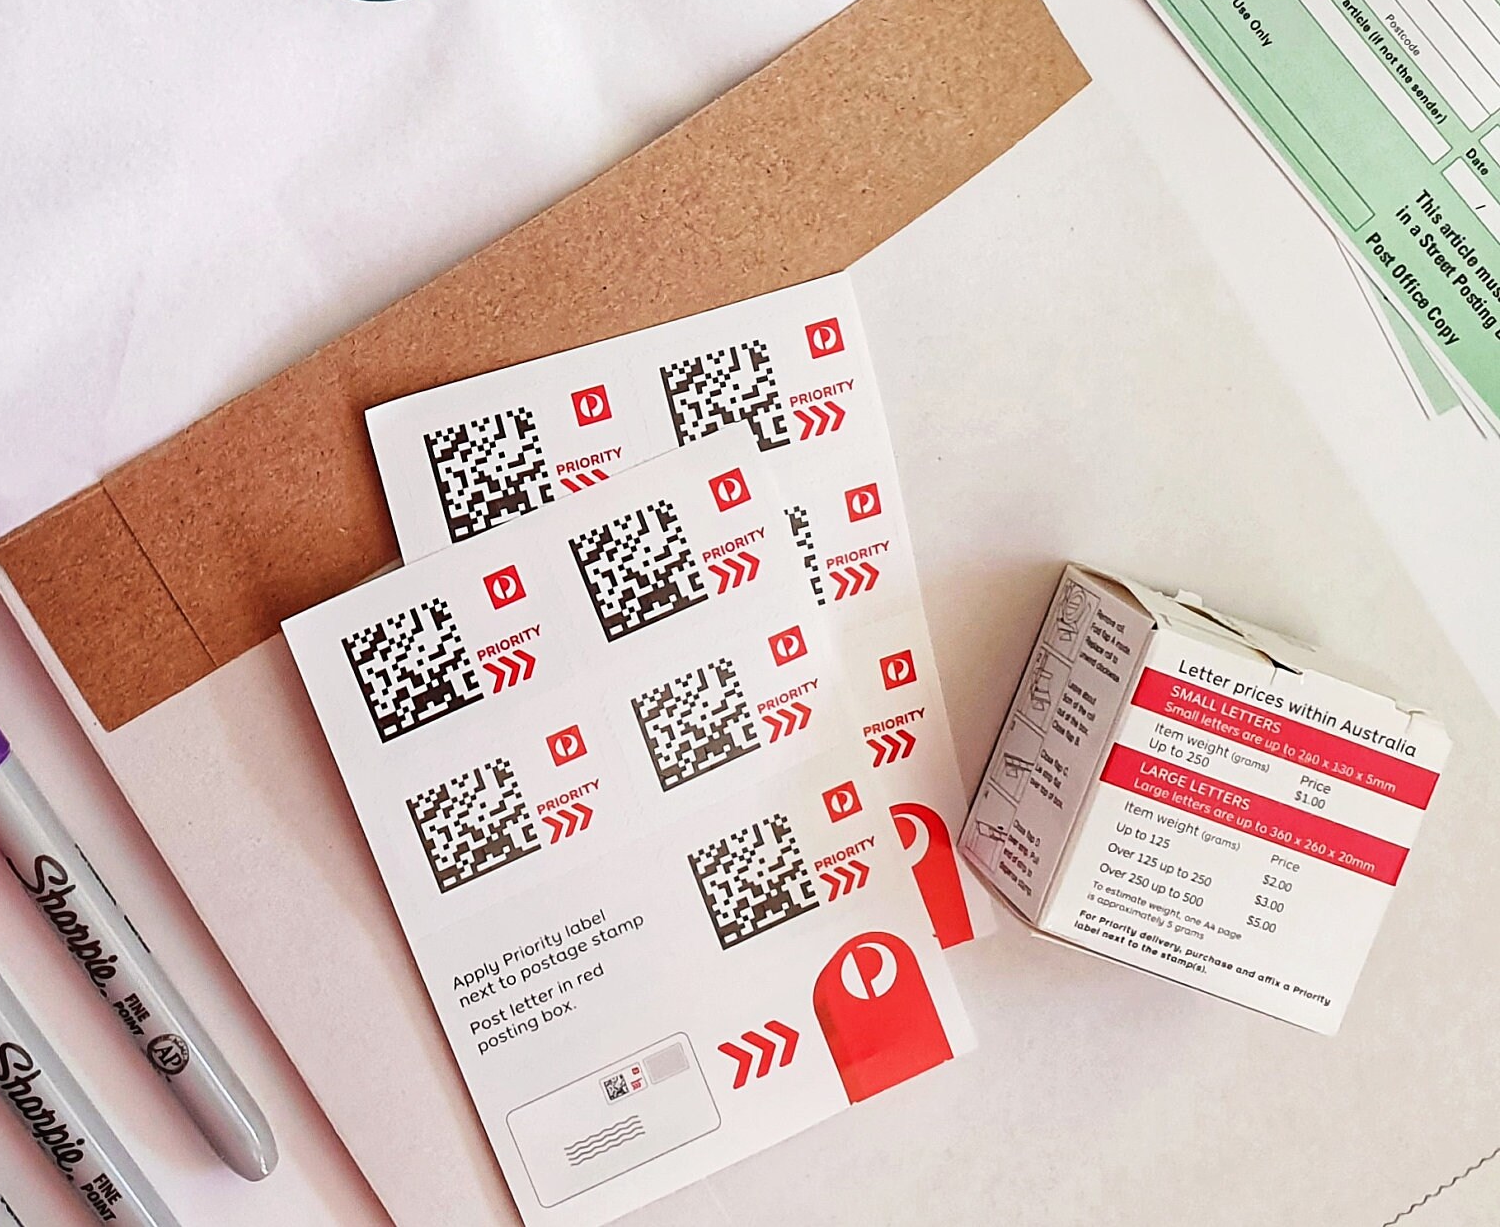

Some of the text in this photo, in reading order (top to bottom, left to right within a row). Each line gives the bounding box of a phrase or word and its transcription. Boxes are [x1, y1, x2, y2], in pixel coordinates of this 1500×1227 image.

[1249, 18, 1273, 47] Only
[1384, 13, 1420, 56] Postcode
[1364, 231, 1460, 345] Post Office Copy
[788, 378, 854, 407] PRIORITY
[555, 446, 622, 476] PRIORITY
[701, 526, 764, 563] PRIORITY
[825, 539, 889, 569] PRIORITY
[476, 623, 540, 661] PRIORITY
[756, 677, 818, 714] PRIORITY
[1169, 684, 1281, 734] SMALL LETTERS
[1177, 658, 1416, 757] Letter prices within Australia
[862, 706, 925, 737] PRIORITY
[1153, 722, 1229, 758] Item weight
[1148, 736, 1210, 768] Up to 250
[536, 778, 599, 815] PRIORITY
[1139, 761, 1251, 810] LARGE LETTERS
[1293, 789, 1326, 809] $1.00
[1299, 774, 1331, 795] Price
[1115, 820, 1171, 849] Up to 125
[1123, 800, 1199, 837] Item weight
[813, 835, 875, 872] PRIORITY
[1106, 841, 1212, 887] Over 125 up to 250
[1269, 853, 1300, 873] Price
[1098, 861, 1204, 907] Over 250 up to 500
[1261, 873, 1293, 893] $2.00
[1253, 893, 1285, 913] $3.00
[5, 854, 116, 997] Sharpie
[1245, 914, 1277, 933] $5.00
[453, 908, 606, 990] Apply Priority label
[458, 914, 644, 1008] next to postage stamp
[123, 992, 150, 1023] FINE
[469, 961, 604, 1035] Post letter in red
[111, 1000, 144, 1035] POINT
[476, 1000, 577, 1055] posting box.
[79, 1182, 116, 1221] POINT
[92, 1172, 122, 1206] FINE
